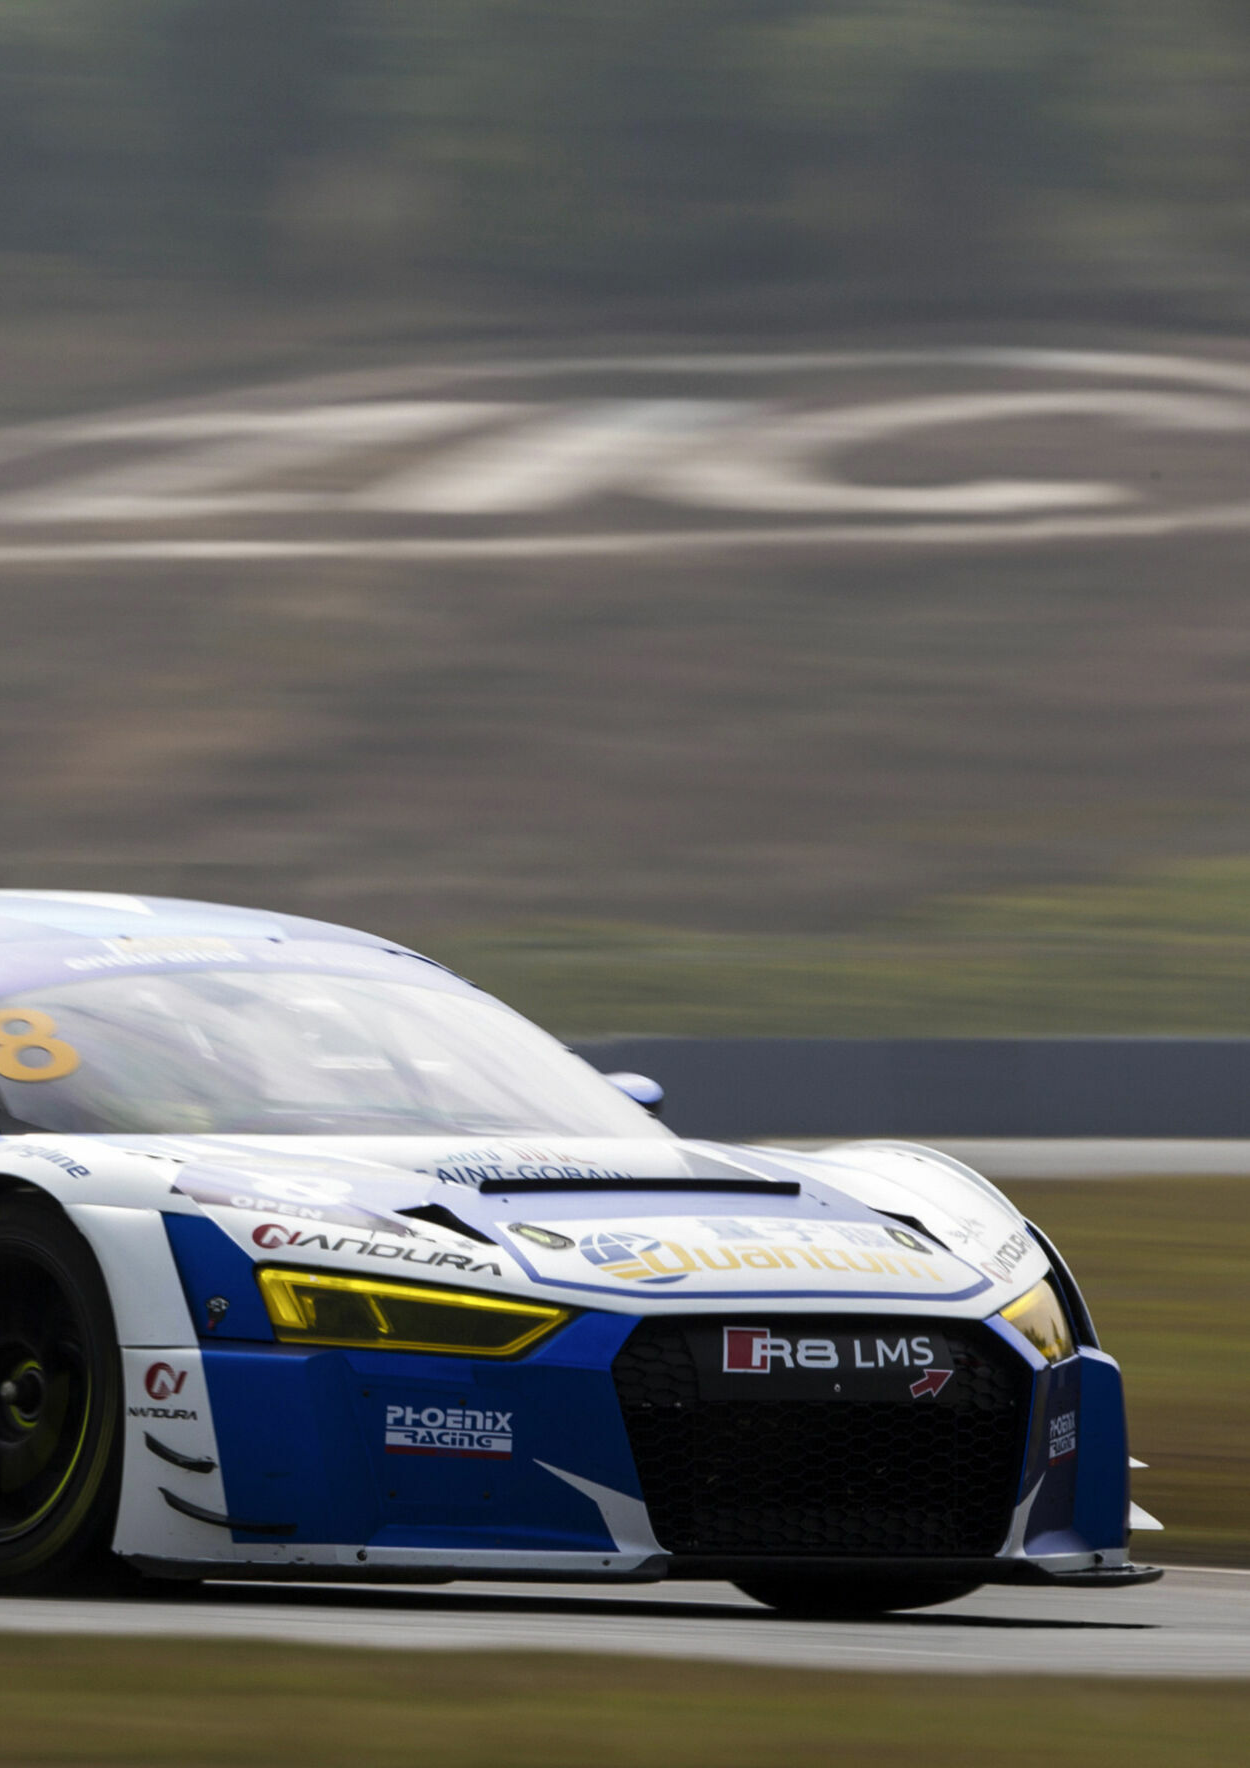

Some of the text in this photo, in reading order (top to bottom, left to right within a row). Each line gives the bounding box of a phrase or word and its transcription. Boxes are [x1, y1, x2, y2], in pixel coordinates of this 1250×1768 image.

[230, 1196, 324, 1221] OPEN
[638, 1240, 945, 1283] Quantum
[751, 1337, 934, 1368] R8 LMS
